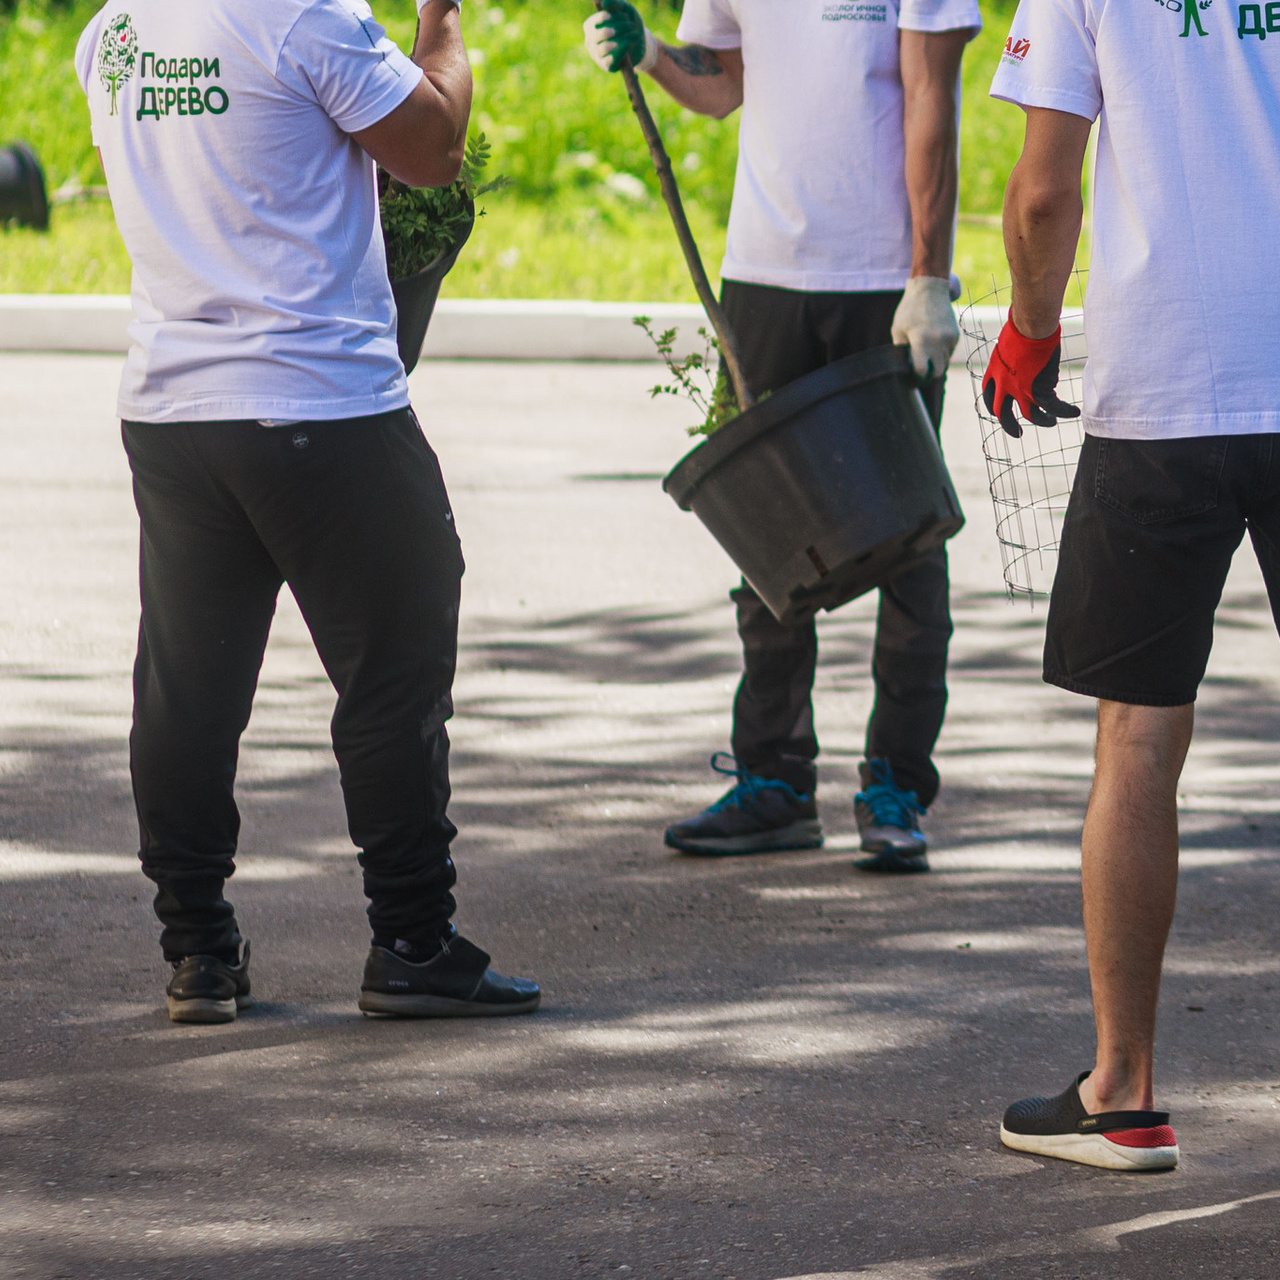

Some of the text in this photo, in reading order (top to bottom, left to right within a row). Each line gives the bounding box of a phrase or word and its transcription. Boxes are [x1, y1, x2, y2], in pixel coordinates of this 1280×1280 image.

[822, 13, 887, 22] ПОДМОСКОВЬЕ
[141, 51, 220, 86] Подари
[136, 86, 229, 121] ДЕРЕВО
